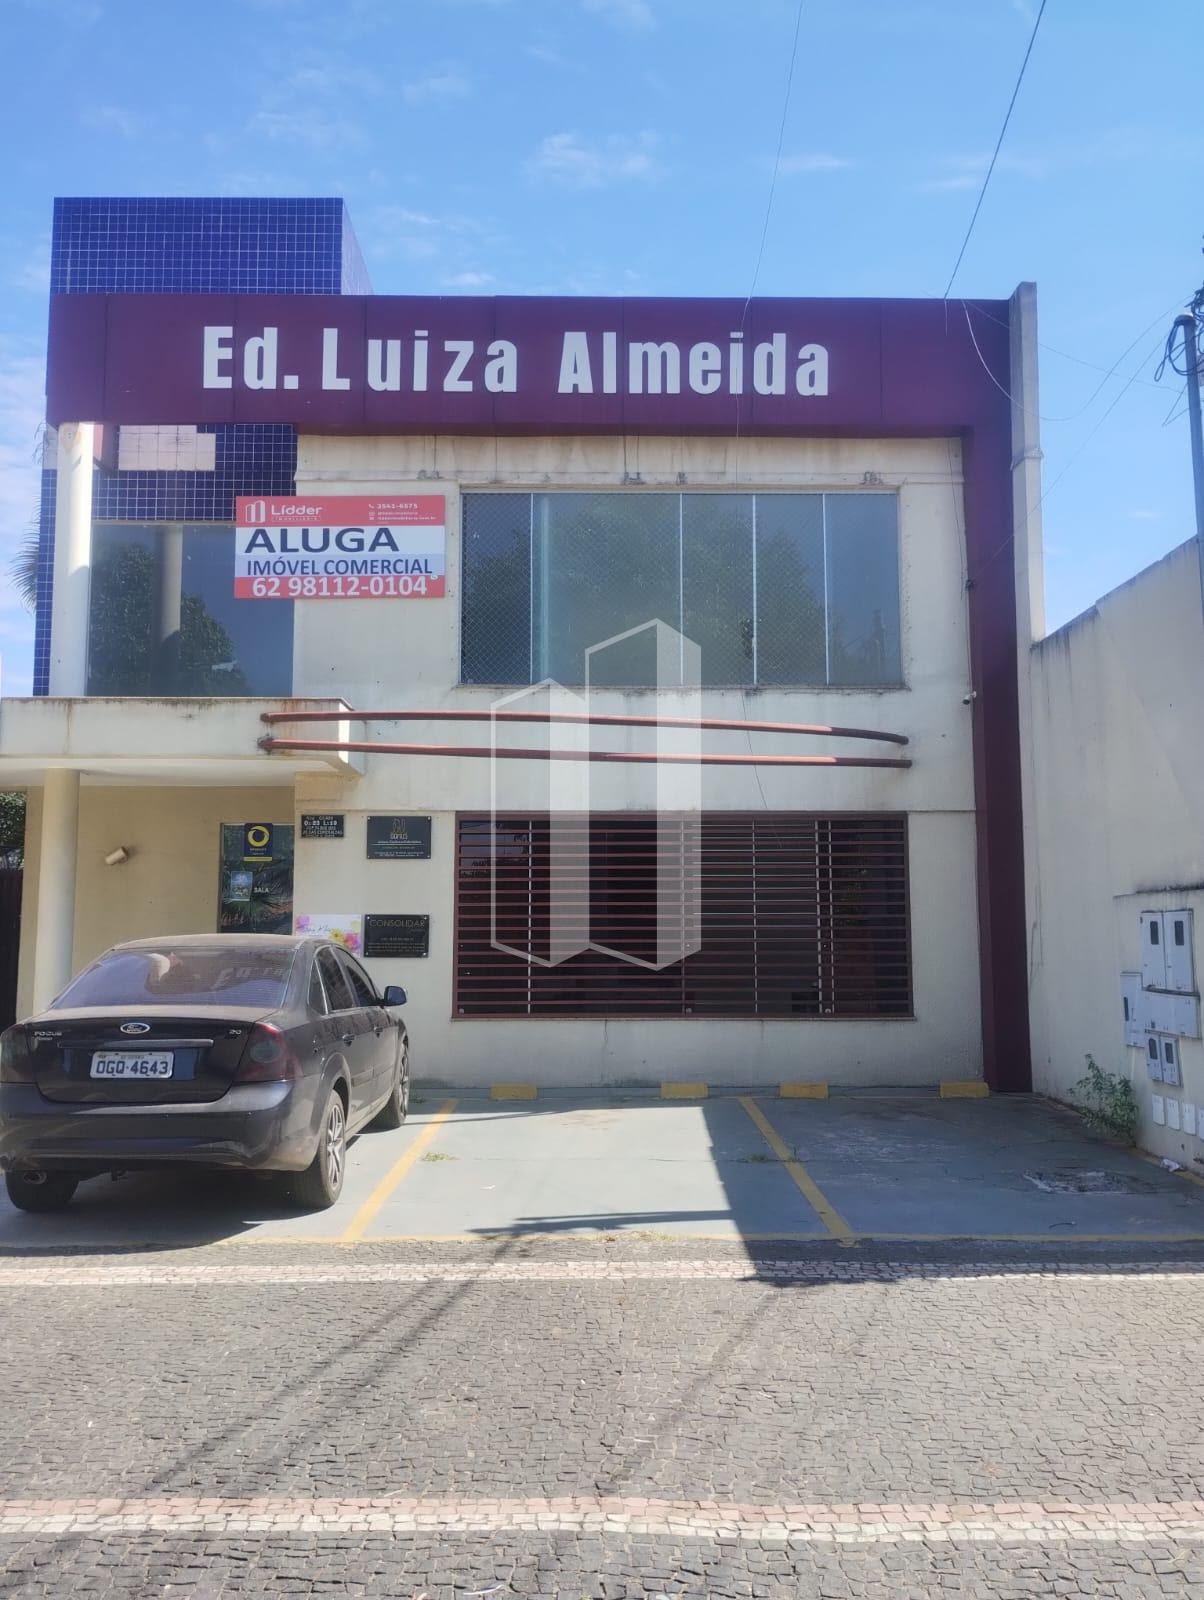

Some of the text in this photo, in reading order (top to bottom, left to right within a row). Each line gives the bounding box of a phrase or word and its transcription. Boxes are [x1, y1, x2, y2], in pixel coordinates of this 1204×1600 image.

[203, 326, 830, 397] Ed. Luiza Almeida
[244, 527, 400, 554] ALUGA
[247, 556, 433, 576] IMÓVEL COMERCIAL
[252, 575, 428, 597] 62 98112-0104
